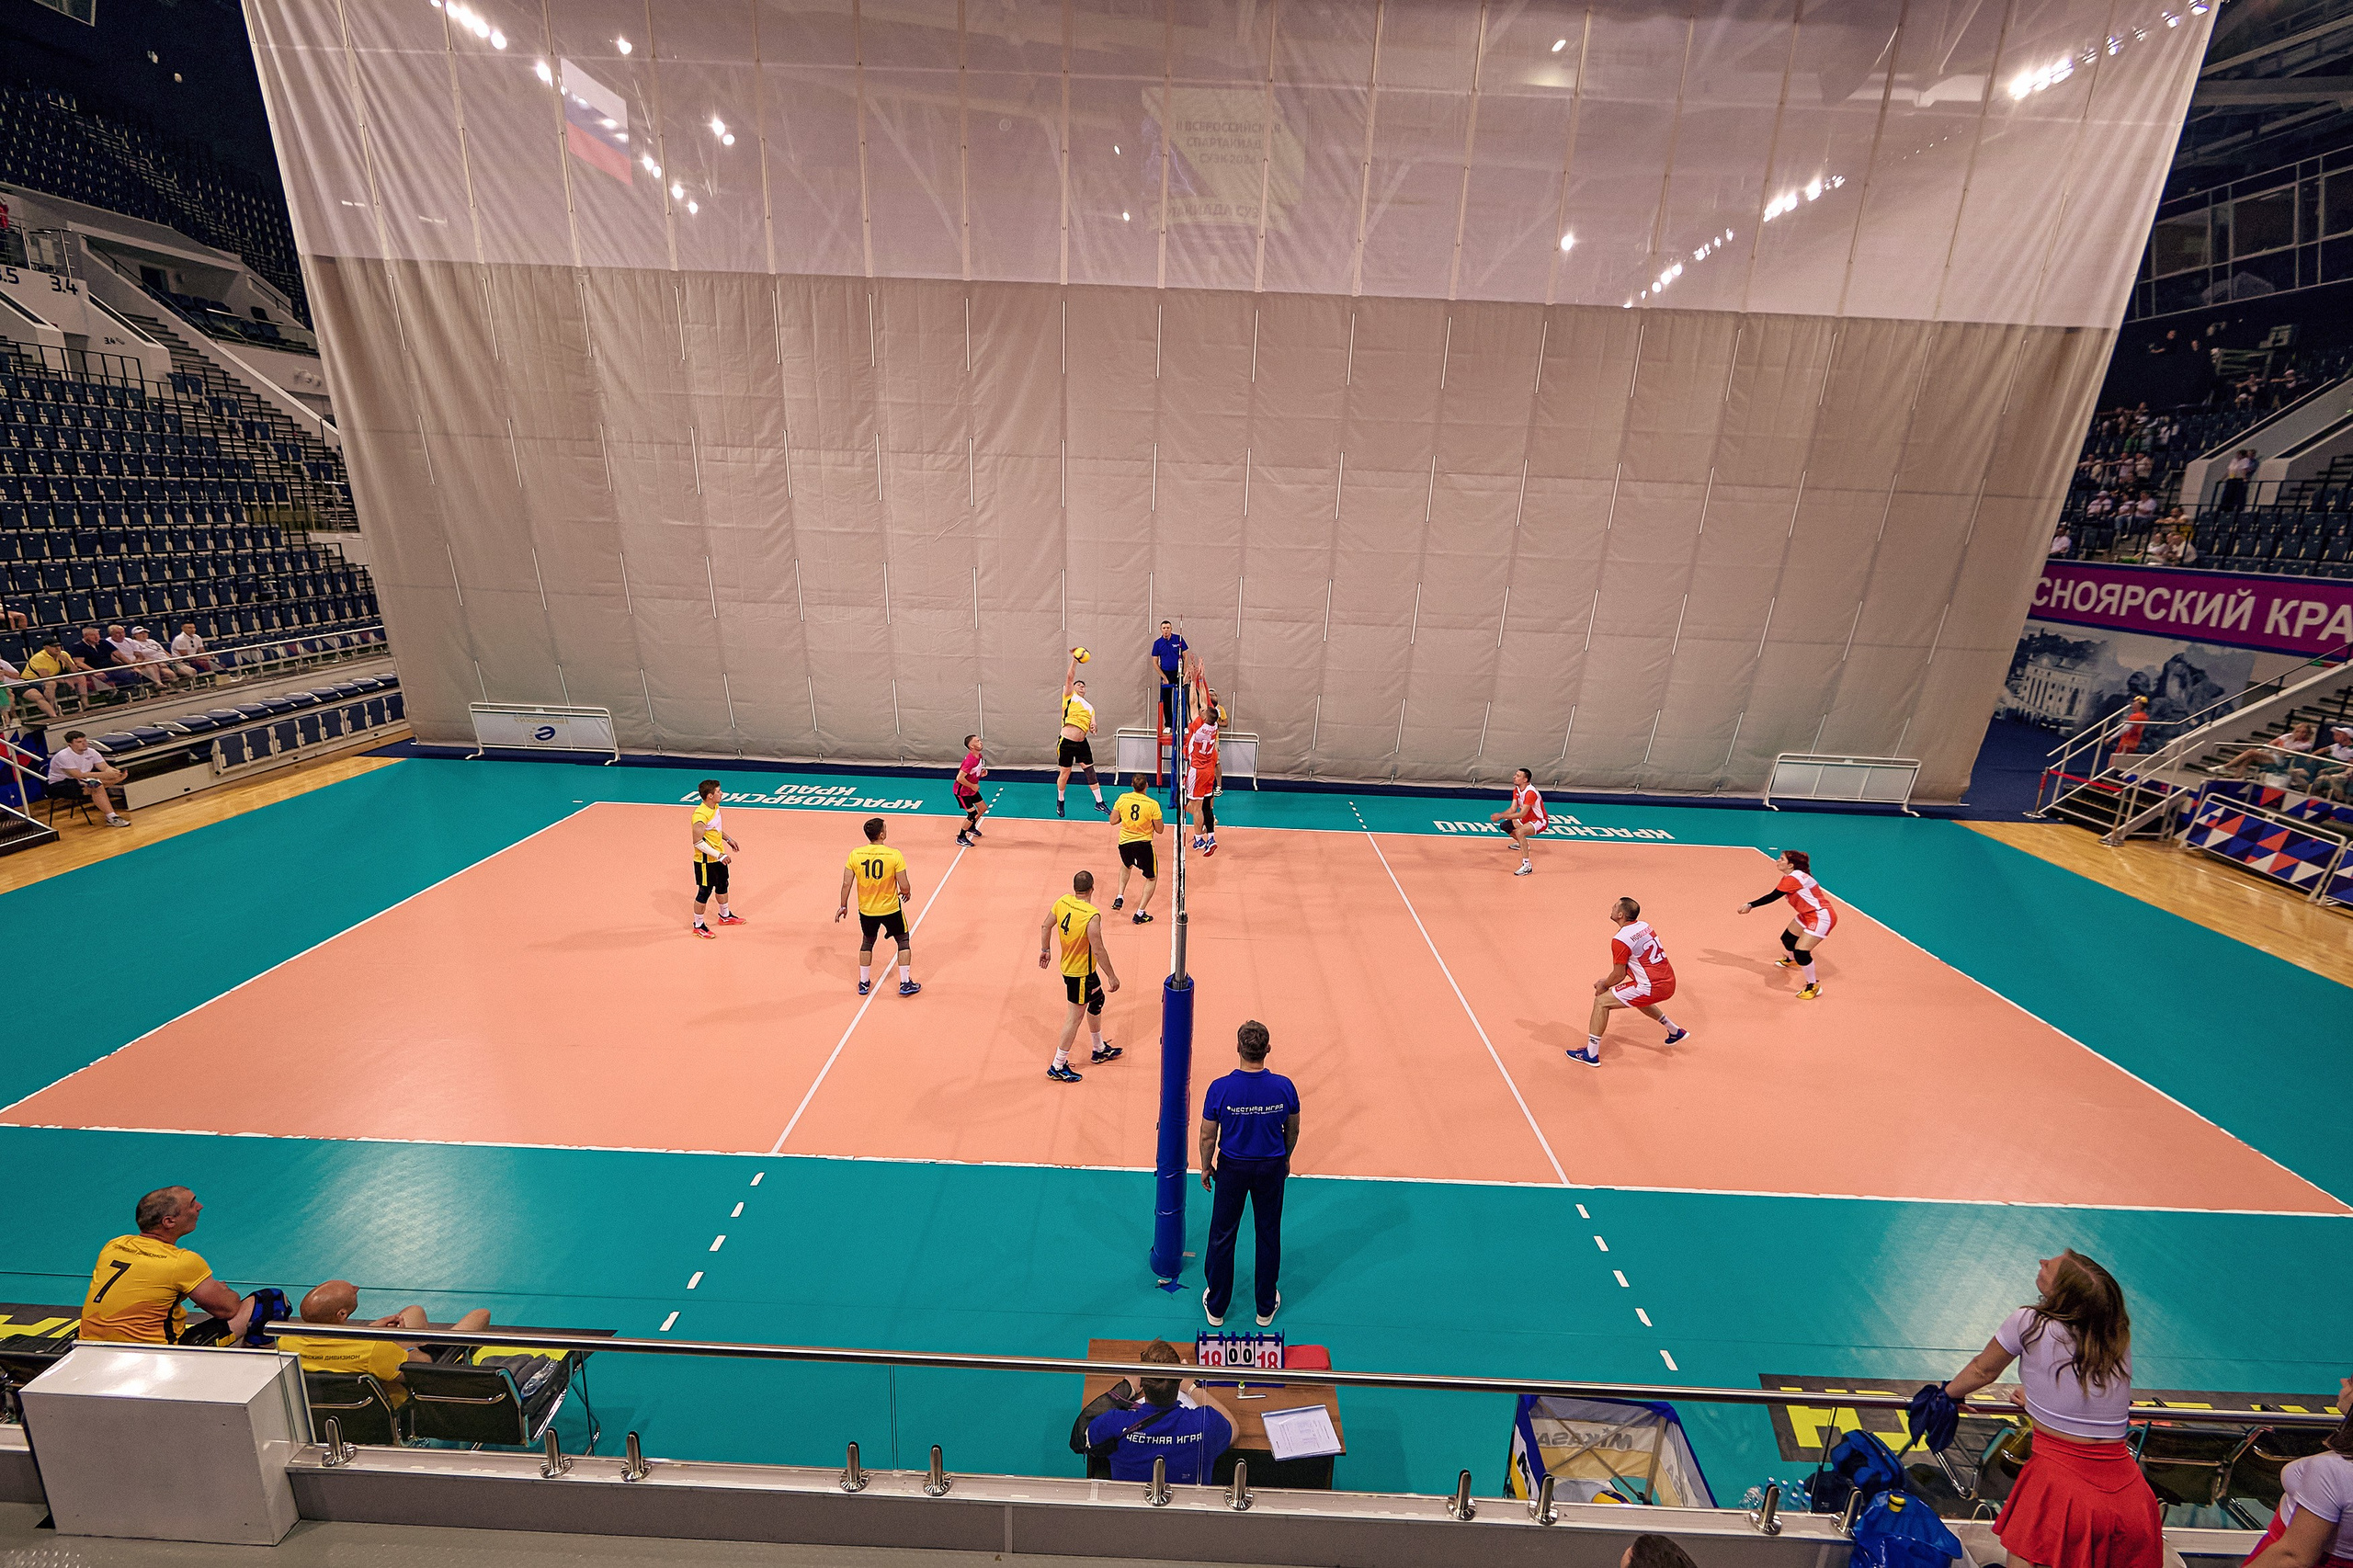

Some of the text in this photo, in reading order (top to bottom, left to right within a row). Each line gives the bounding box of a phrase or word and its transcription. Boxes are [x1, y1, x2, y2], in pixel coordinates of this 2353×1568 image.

[1185, 120, 1281, 134] ВСЕРОССИЙСКЯ
[1187, 136, 1263, 150] СПАРТАКИАД
[0, 266, 19, 285] .5
[50, 275, 78, 295] 3.4
[774, 784, 857, 796] КРАЙ
[1131, 803, 1140, 821] 8
[861, 858, 883, 880] 10
[1061, 912, 1071, 936] 4
[93, 1259, 132, 1303] 7
[1126, 1432, 1202, 1445] ЧЕСТНАЯ ИГРА
